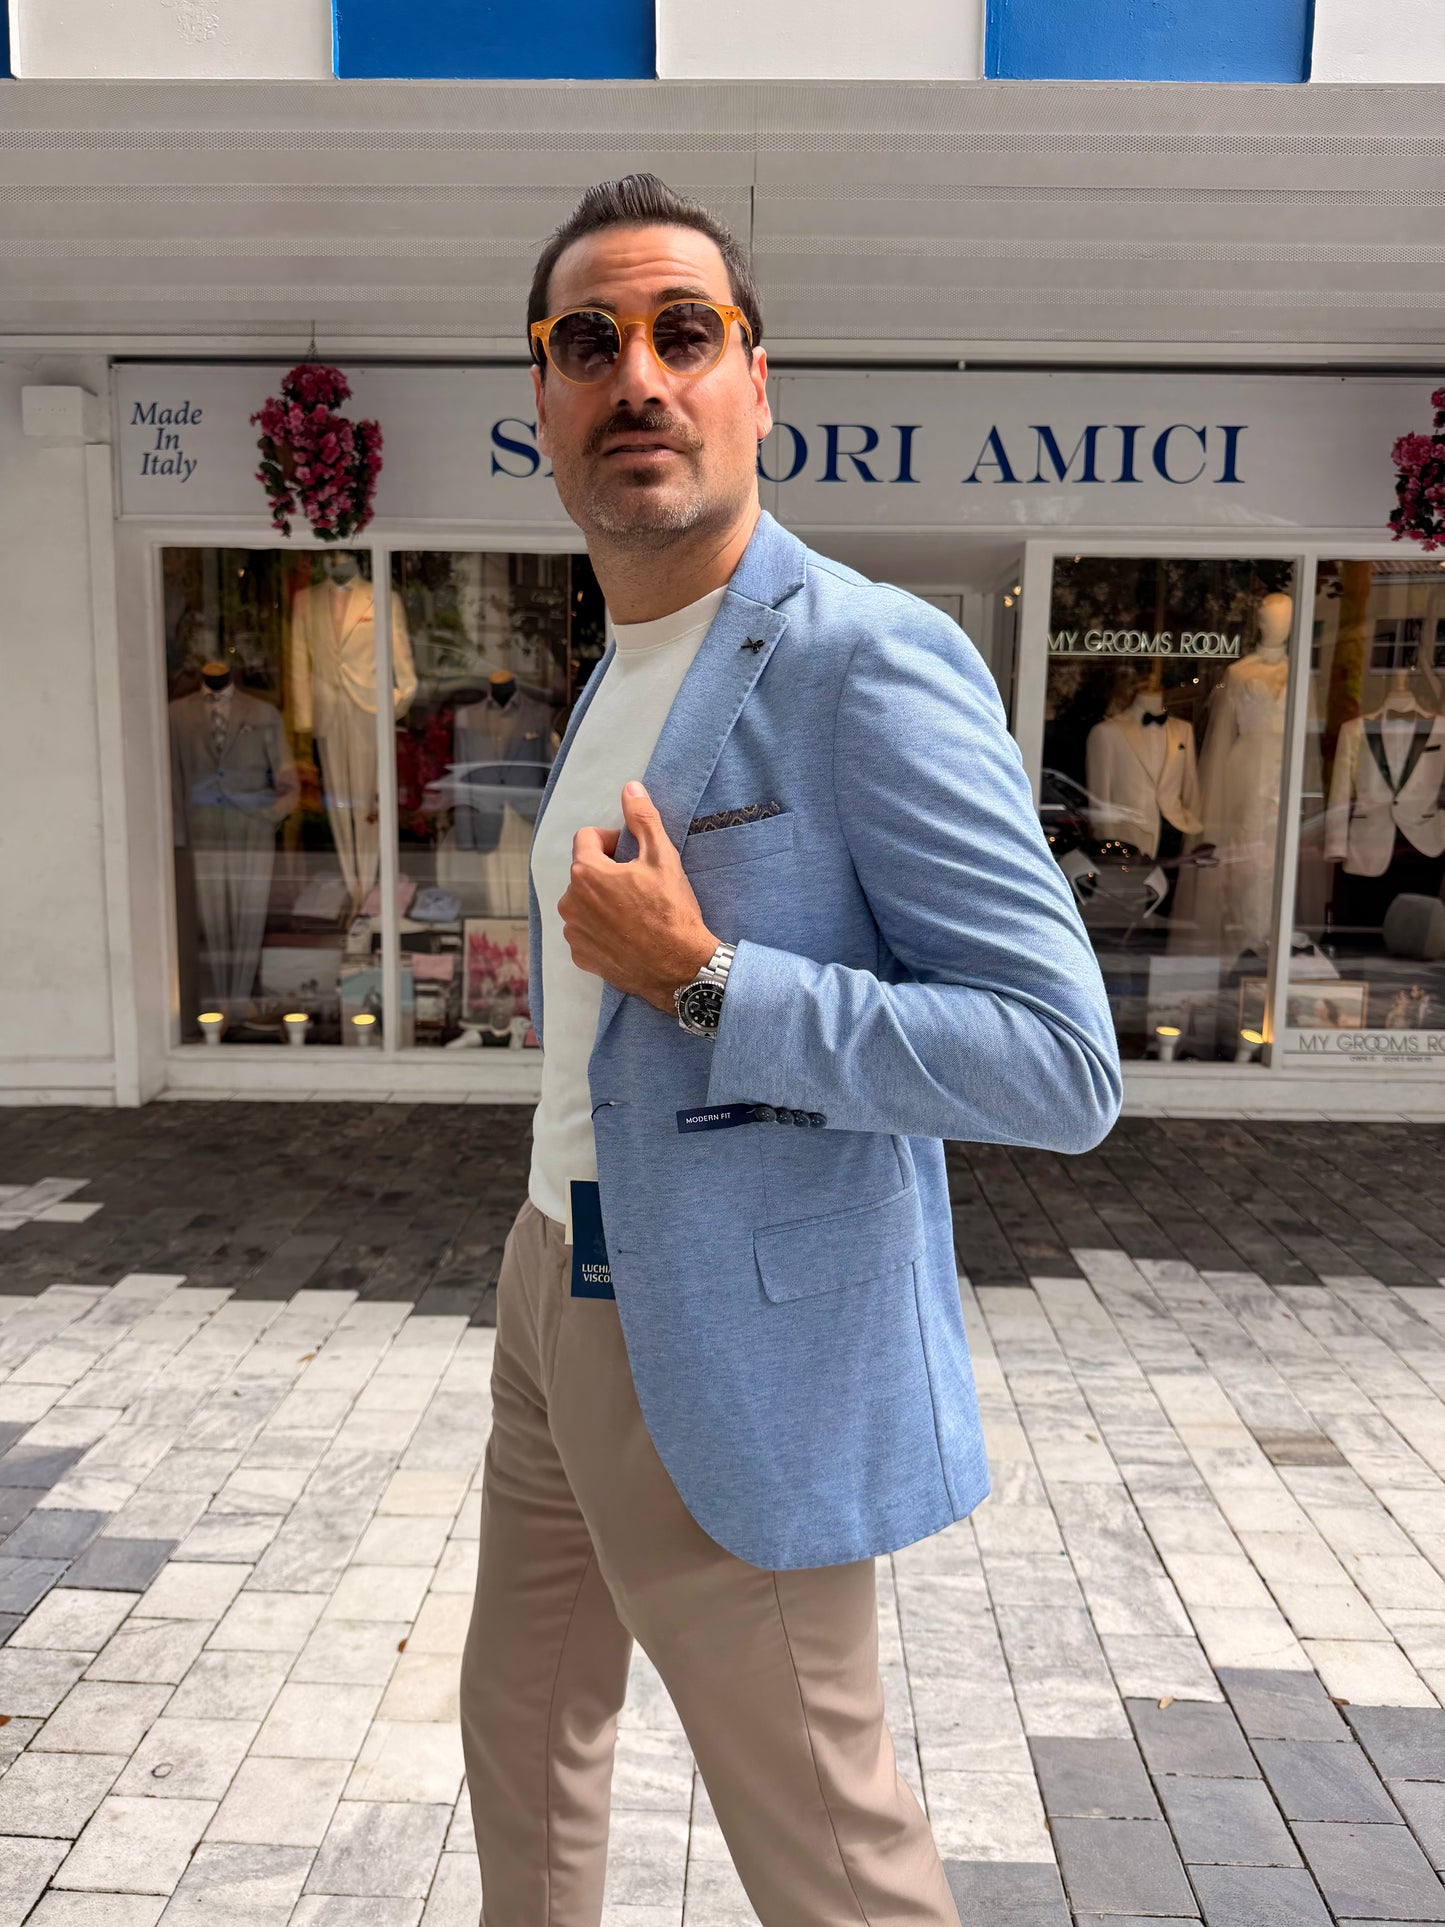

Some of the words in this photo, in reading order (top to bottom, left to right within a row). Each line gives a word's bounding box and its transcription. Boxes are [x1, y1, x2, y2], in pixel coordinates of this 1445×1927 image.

[130, 400, 203, 425] Made
[154, 427, 180, 451] In
[961, 424, 1249, 484] AMICI
[140, 451, 198, 483] Italy
[1047, 630, 1080, 651] MY
[1084, 629, 1173, 654] GROOMS
[1180, 631, 1241, 655] ROOM
[1299, 1034, 1330, 1051] MY
[1336, 1033, 1419, 1053] GROOMS
[685, 1114, 719, 1124] MODERN
[720, 1112, 731, 1120] FIT
[581, 1263, 610, 1274] LUCHI
[583, 1273, 612, 1283] VISCO
